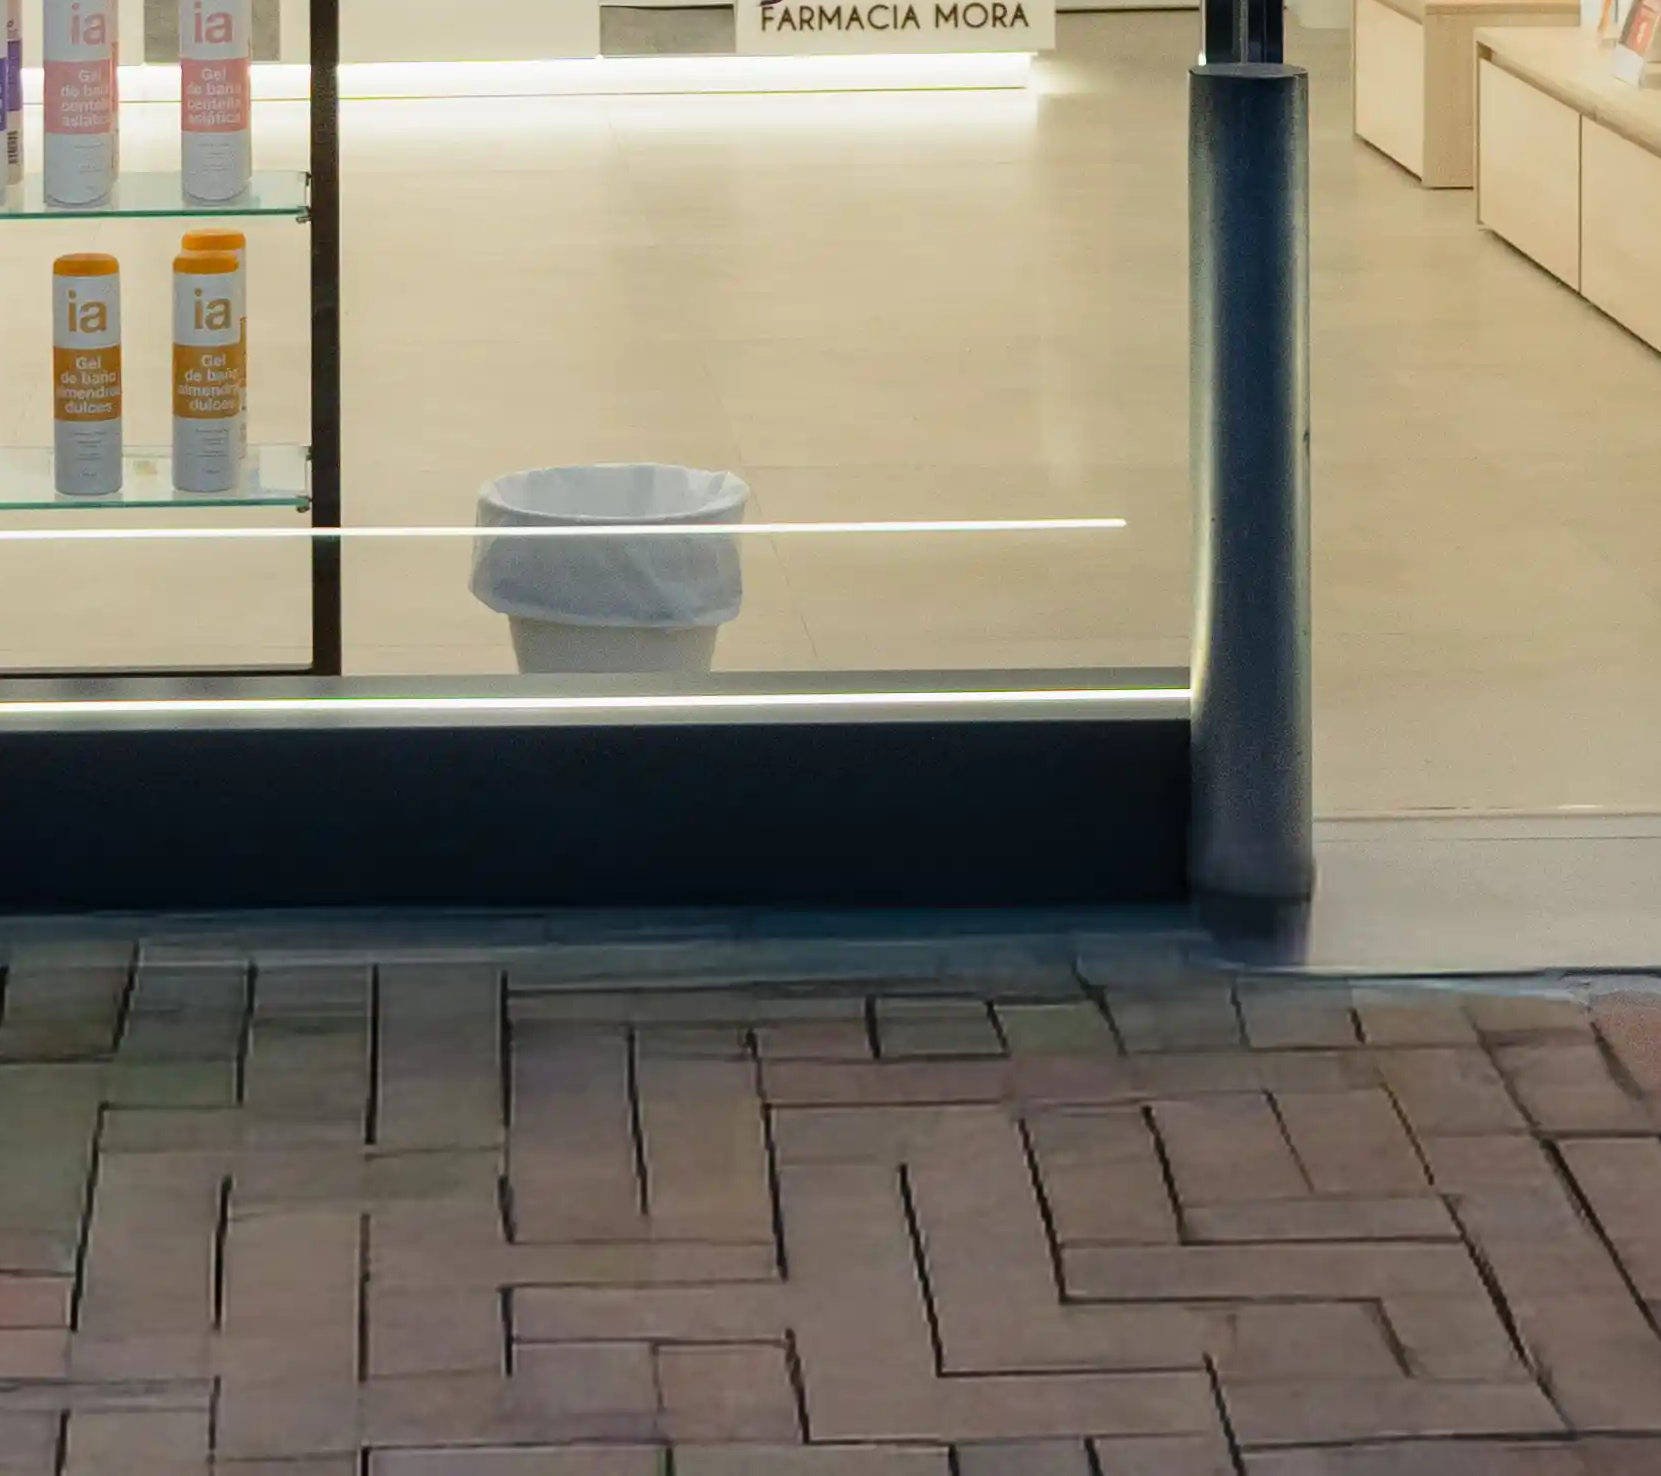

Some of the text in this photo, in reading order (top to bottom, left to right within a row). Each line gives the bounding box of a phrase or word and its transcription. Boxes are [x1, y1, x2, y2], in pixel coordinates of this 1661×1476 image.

[71, 3, 107, 45] ia
[193, 1, 233, 43] ia
[760, 3, 1029, 32] FARMACIA MORA
[78, 70, 101, 82] Gel
[201, 68, 226, 81] Gel
[68, 291, 108, 333] ia
[194, 288, 231, 329] ia
[76, 356, 101, 369] Gel
[201, 354, 227, 367] Gel
[61, 371, 116, 384] de baño
[184, 370, 202, 381] de
[64, 400, 113, 414] dulces
